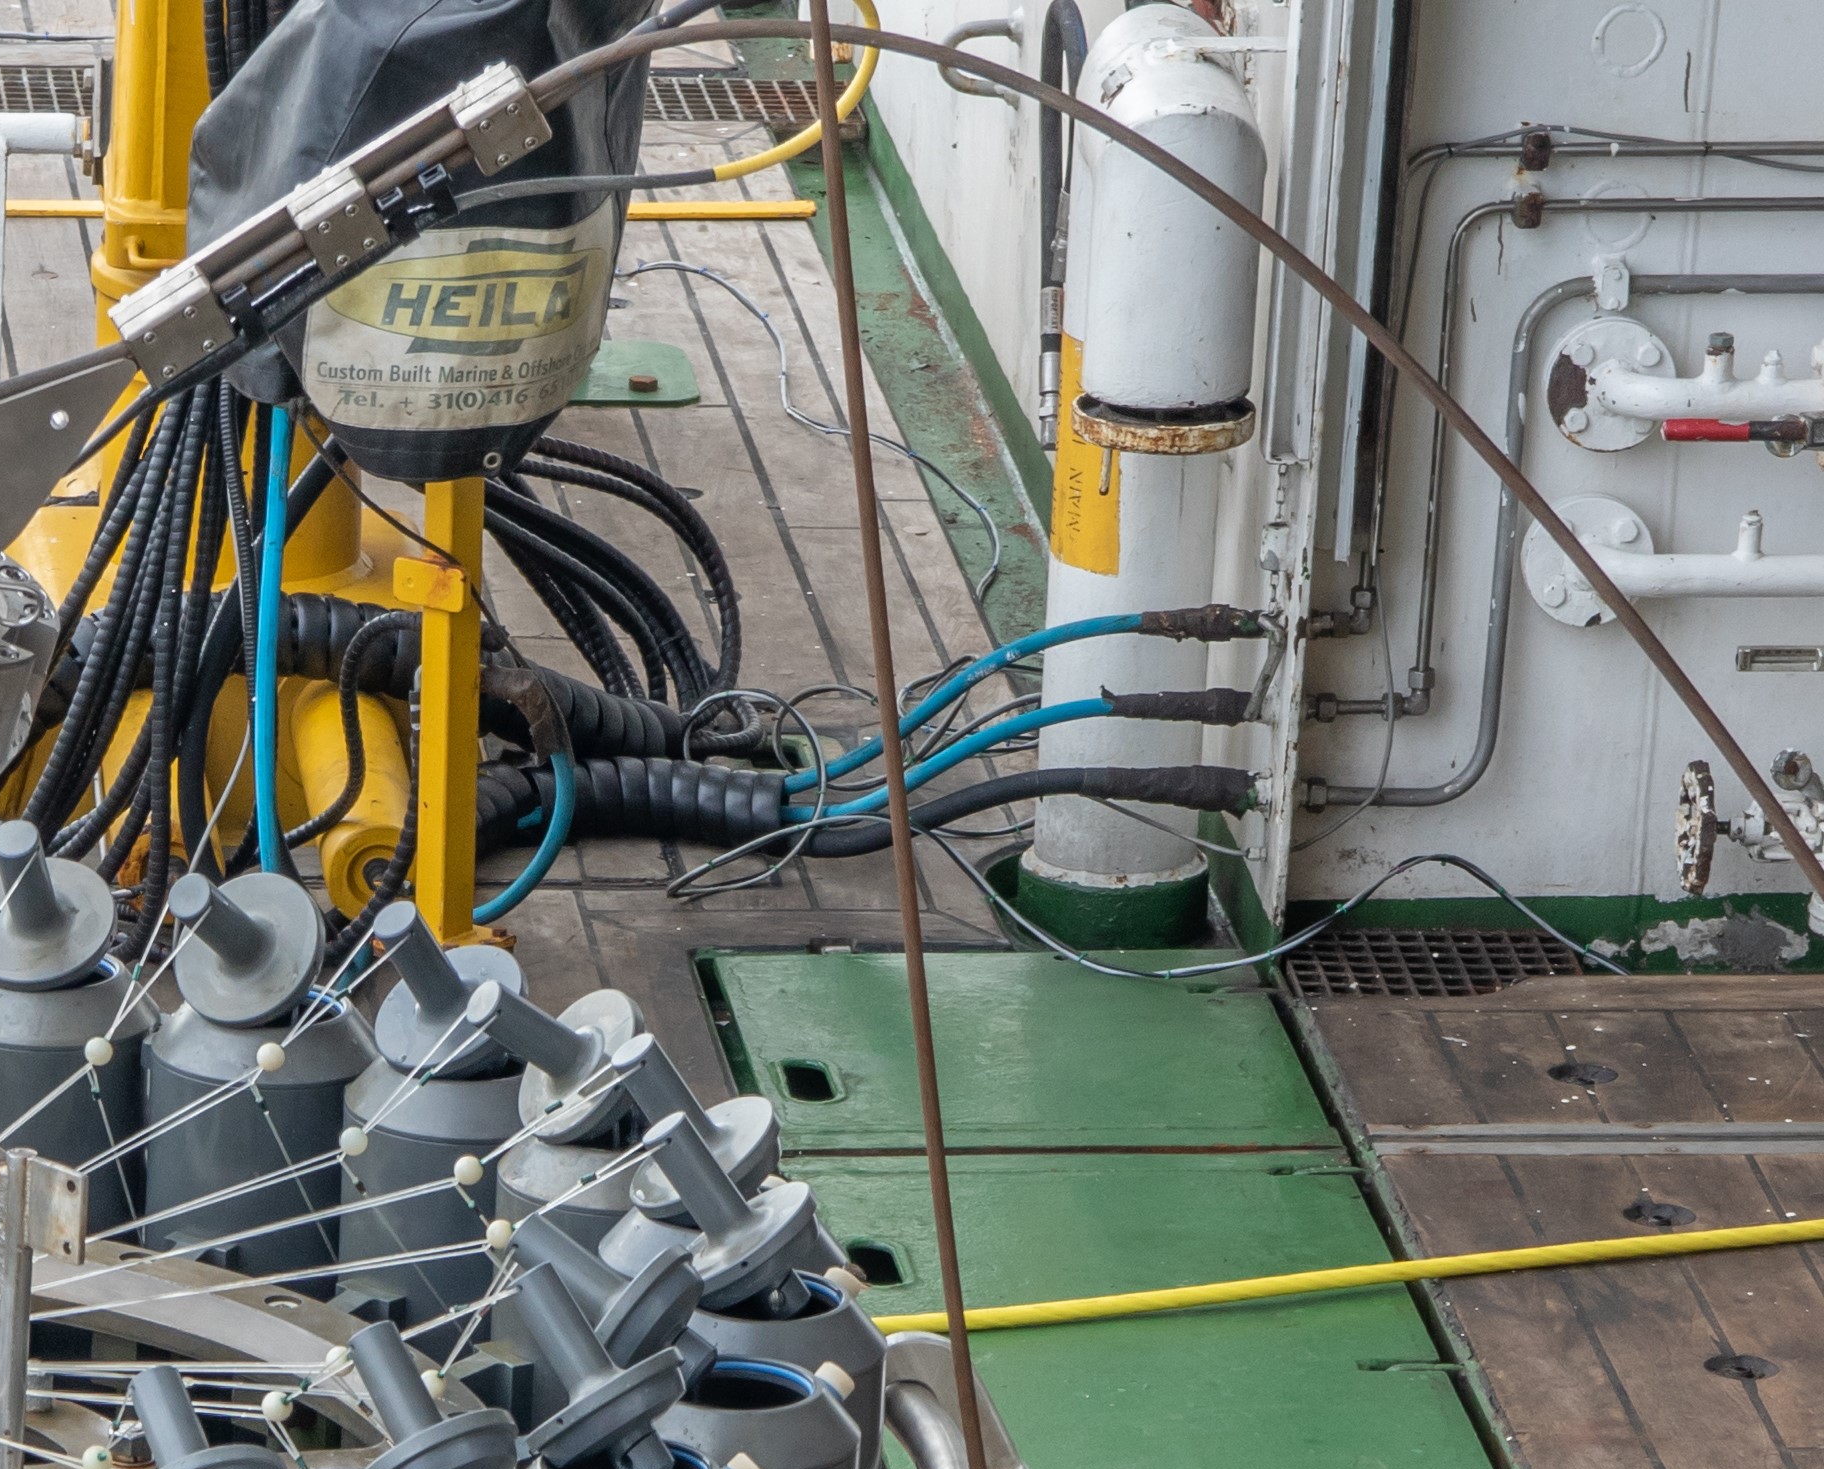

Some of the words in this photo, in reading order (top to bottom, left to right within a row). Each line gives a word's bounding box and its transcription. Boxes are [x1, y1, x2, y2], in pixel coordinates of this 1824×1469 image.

[381, 281, 572, 328] HEILA
[317, 361, 383, 382] Custom
[390, 363, 431, 383] Built
[438, 364, 497, 383] Marine
[502, 367, 514, 380] &
[519, 352, 573, 379] Offshore
[338, 389, 384, 408] Tel.
[400, 396, 413, 408] +
